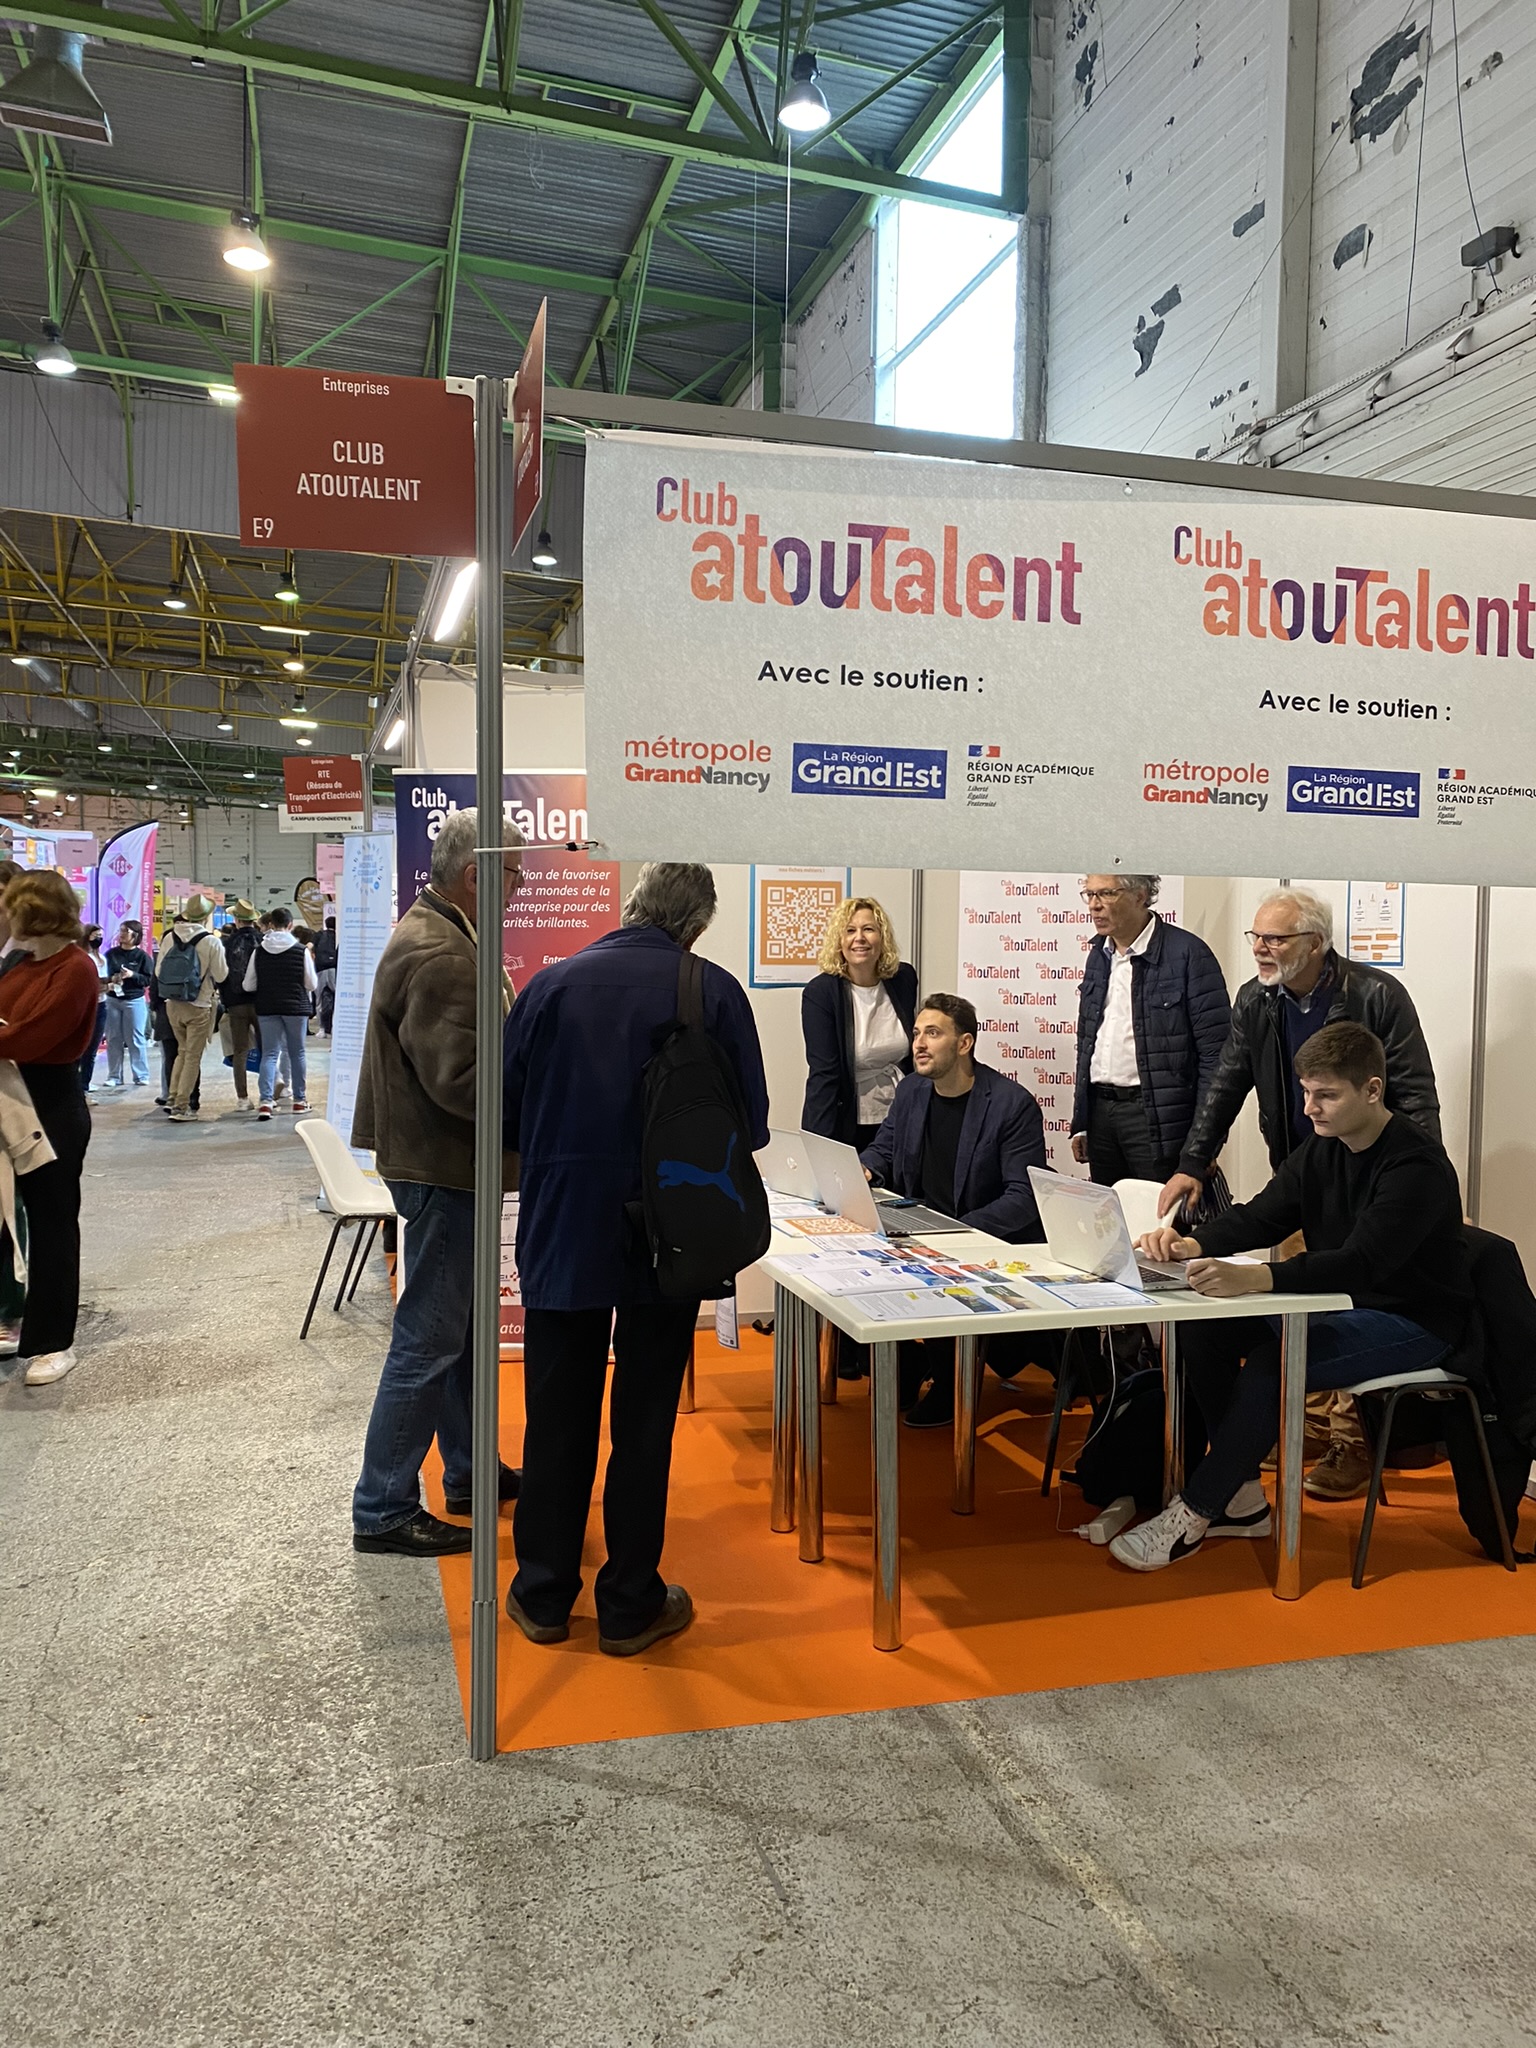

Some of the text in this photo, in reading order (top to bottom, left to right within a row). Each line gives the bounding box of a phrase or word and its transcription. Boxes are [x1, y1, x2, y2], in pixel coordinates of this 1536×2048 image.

[322, 376, 390, 398] Entreprises
[332, 440, 385, 466] CLUB
[296, 472, 422, 502] ATOUTALENT
[656, 476, 738, 527] Club
[252, 517, 275, 539] E9
[1174, 525, 1243, 570] Club
[690, 514, 1083, 625] atouTalent
[1202, 558, 1536, 660] atouTalent
[757, 660, 984, 694] Avec le soutien :
[1258, 690, 1451, 721] Avec le soutien :
[624, 735, 772, 766] métropole
[823, 751, 884, 764] La Région
[317, 770, 331, 779] RTE
[967, 760, 1095, 777] RÉGION ACADÉMIQUE
[1143, 758, 1270, 787] métropole
[306, 781, 343, 791] (Réseau de
[966, 773, 1035, 785] GRAND EST
[1313, 773, 1366, 786] La Région
[1437, 782, 1476, 794] RÉGION
[288, 793, 321, 803] Transport
[411, 787, 447, 808] Club
[1436, 793, 1495, 806] GRAND EST
[290, 805, 303, 813] E10
[414, 869, 428, 880] Le
[545, 869, 560, 880] de
[561, 869, 611, 882] favoriser
[536, 885, 579, 897] mondes
[582, 885, 596, 897] de
[599, 885, 611, 897] la
[1005, 882, 1060, 896] atouTalent
[562, 903, 588, 915] pour
[590, 901, 611, 912] des
[503, 917, 590, 928] arités brillantes.
[968, 911, 1022, 924] atouTalent
[1041, 910, 1093, 924] atouTalen
[1003, 938, 1058, 952] atouTalent
[967, 966, 1020, 979] atouTalent
[1040, 966, 1084, 980] atouTale
[1002, 992, 1057, 1006] atouTalent
[977, 1018, 1019, 1033] ouTalent
[1039, 1020, 1078, 1034] atouTal
[1001, 1046, 1056, 1060] atouTalent
[1038, 1071, 1076, 1085] atouTal
